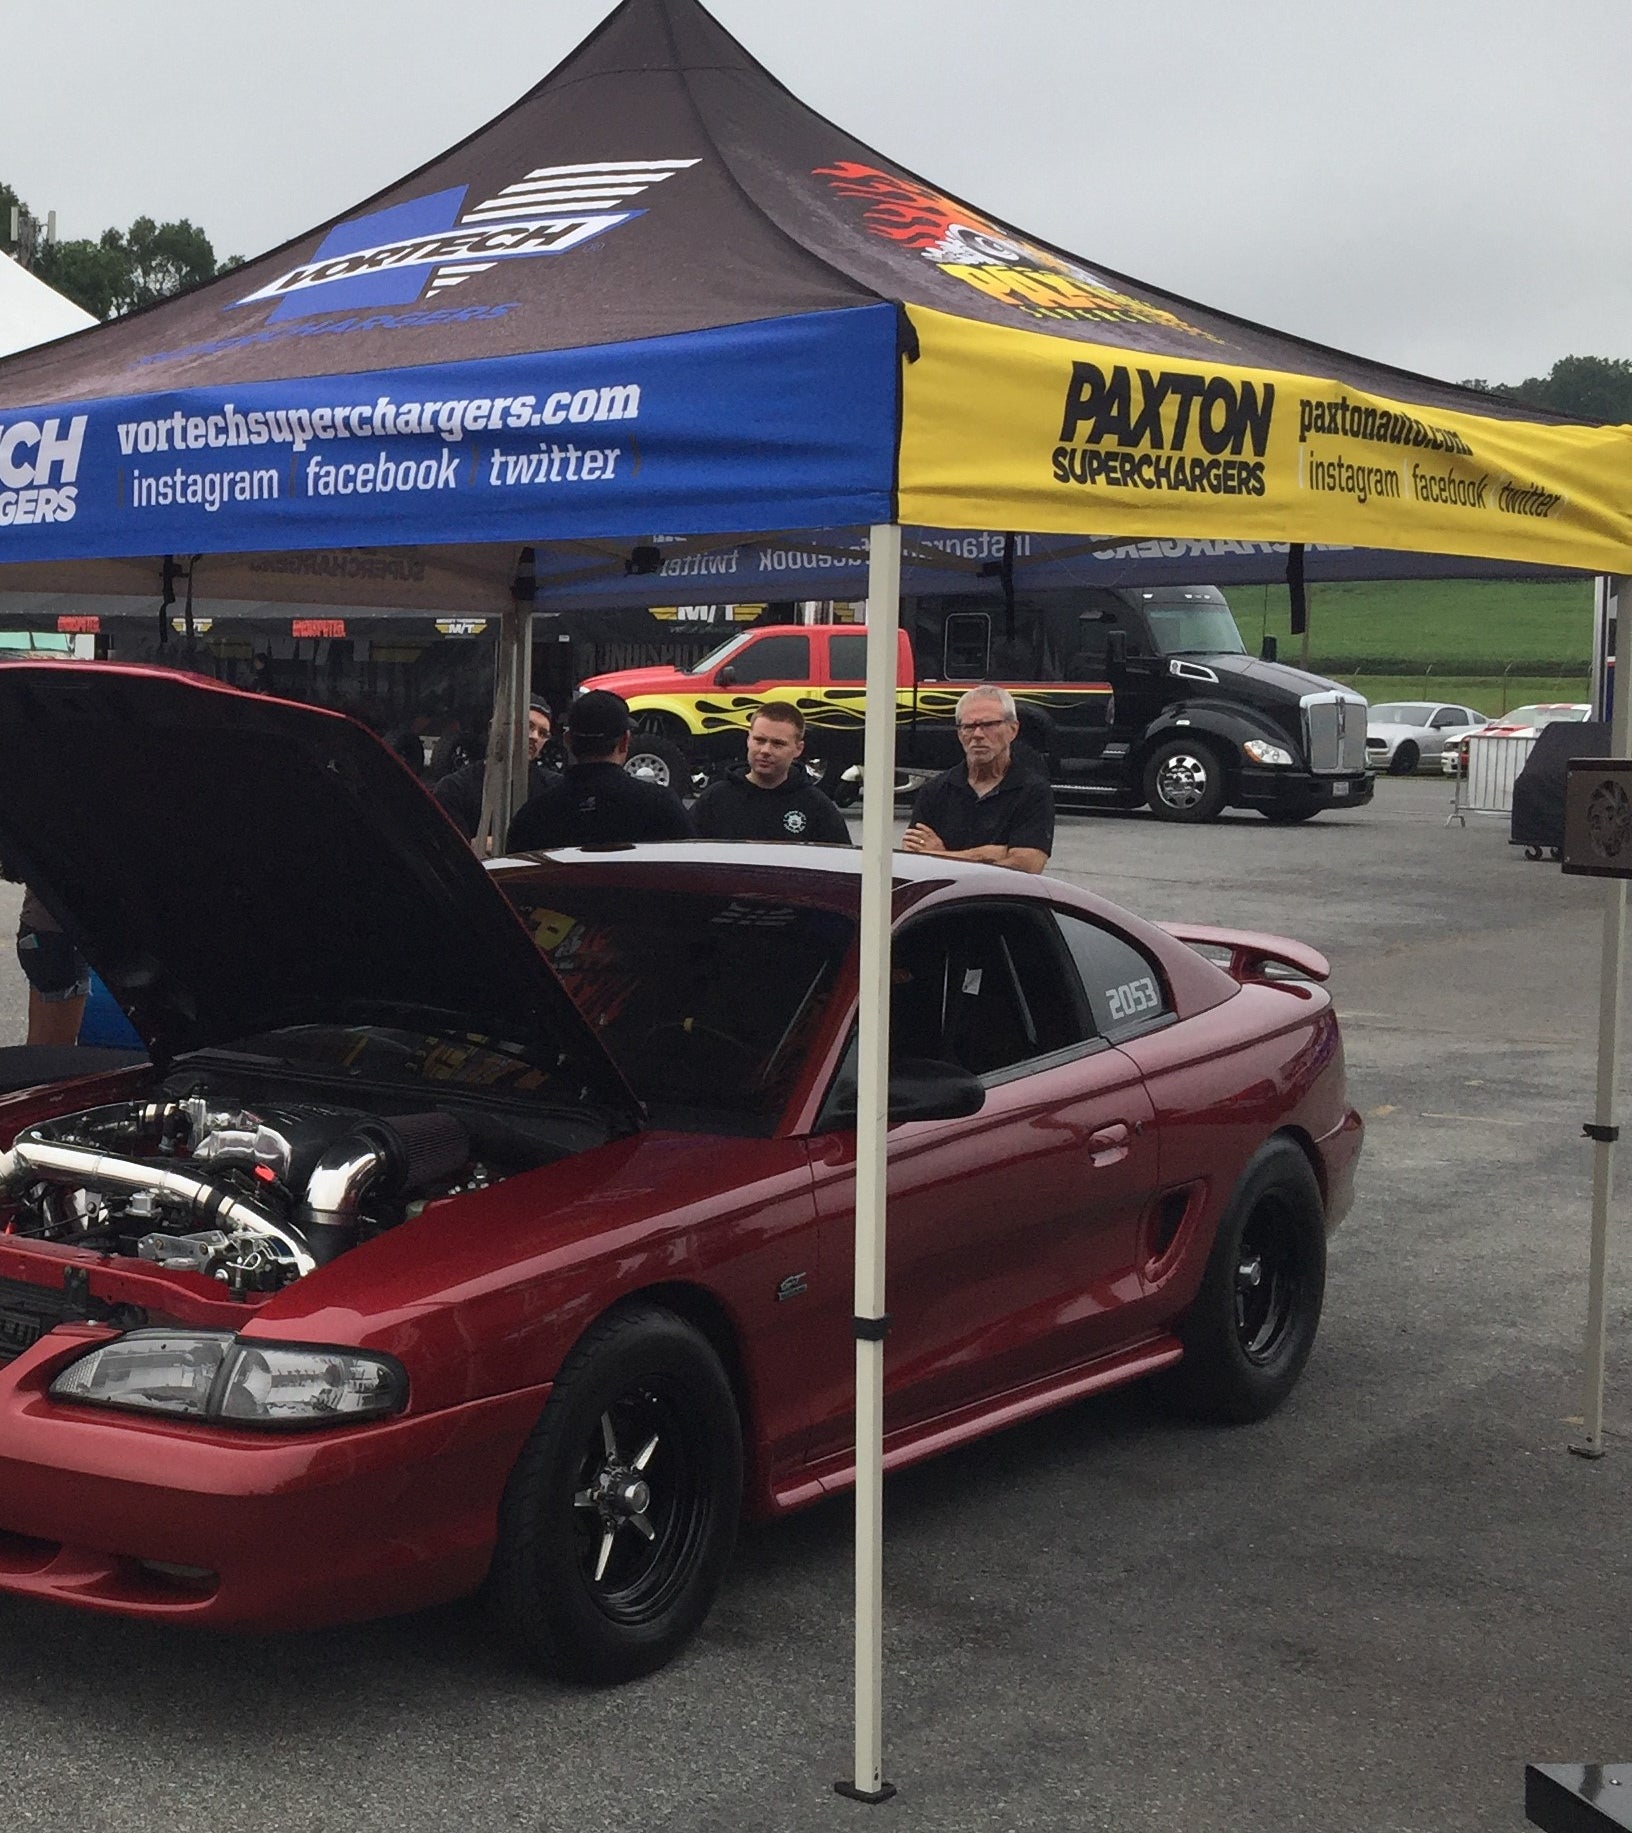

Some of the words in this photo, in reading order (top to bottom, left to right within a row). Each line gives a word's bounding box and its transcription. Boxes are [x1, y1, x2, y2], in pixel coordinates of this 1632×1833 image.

[276, 222, 586, 291] VORTECH
[118, 383, 640, 455] vortechsuperchargers.com
[1062, 361, 1275, 457] PAXTON
[132, 463, 279, 511] instagram
[305, 448, 460, 496] facebook
[489, 440, 622, 486] twitter
[1052, 445, 1266, 496] SUPERCHARGERS
[1309, 451, 1400, 505] instagram
[1411, 463, 1488, 509] facebook
[1496, 481, 1562, 519] twitter
[1105, 977, 1158, 1020] 2053
